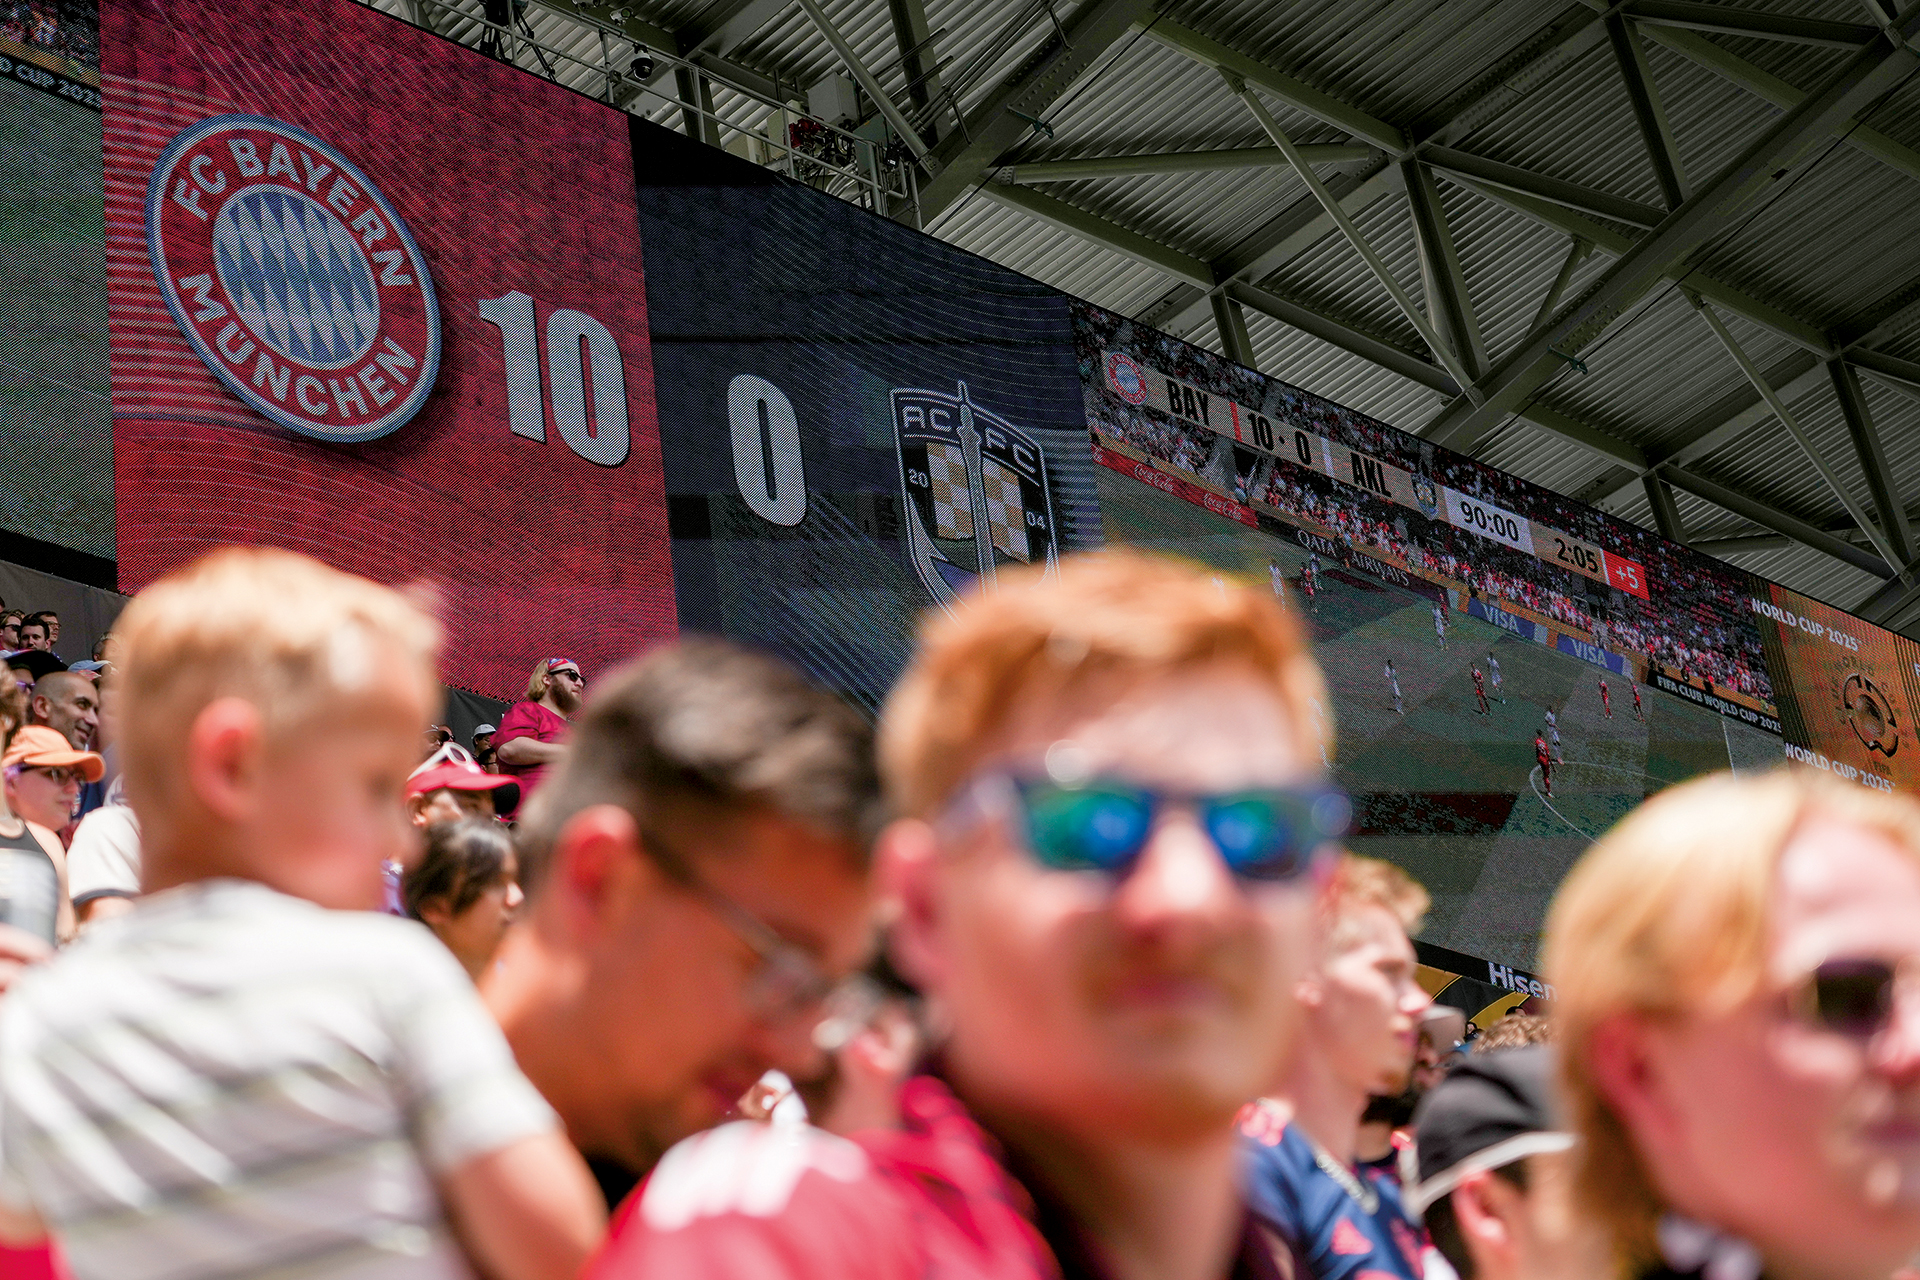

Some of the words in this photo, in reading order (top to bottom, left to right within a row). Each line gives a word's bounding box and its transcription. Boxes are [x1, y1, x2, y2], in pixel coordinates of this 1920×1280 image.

[15, 63, 55, 88] CUP
[172, 154, 227, 221] FC
[228, 138, 412, 287] BAYERN
[478, 290, 630, 467] 10
[727, 373, 807, 527] 0
[1166, 379, 1209, 426] BAY
[1248, 413, 1275, 451] 10
[1295, 430, 1312, 465] 0
[1351, 452, 1392, 498] AKL
[908, 468, 929, 488] 20
[1025, 511, 1046, 530] 04
[1460, 501, 1519, 542] 90:00
[1297, 530, 1337, 558] QATA
[1554, 538, 1598, 573] 2:05
[1616, 566, 1639, 590] +5
[1483, 603, 1520, 633] VISA
[1799, 617, 1825, 638] CUP
[1570, 638, 1608, 668] VISA
[1656, 675, 1679, 693] FIFA
[1680, 684, 1703, 703] CLUB
[1703, 693, 1739, 716] WORLD
[1740, 708, 1759, 723] CUP
[1832, 760, 1858, 781] CUP
